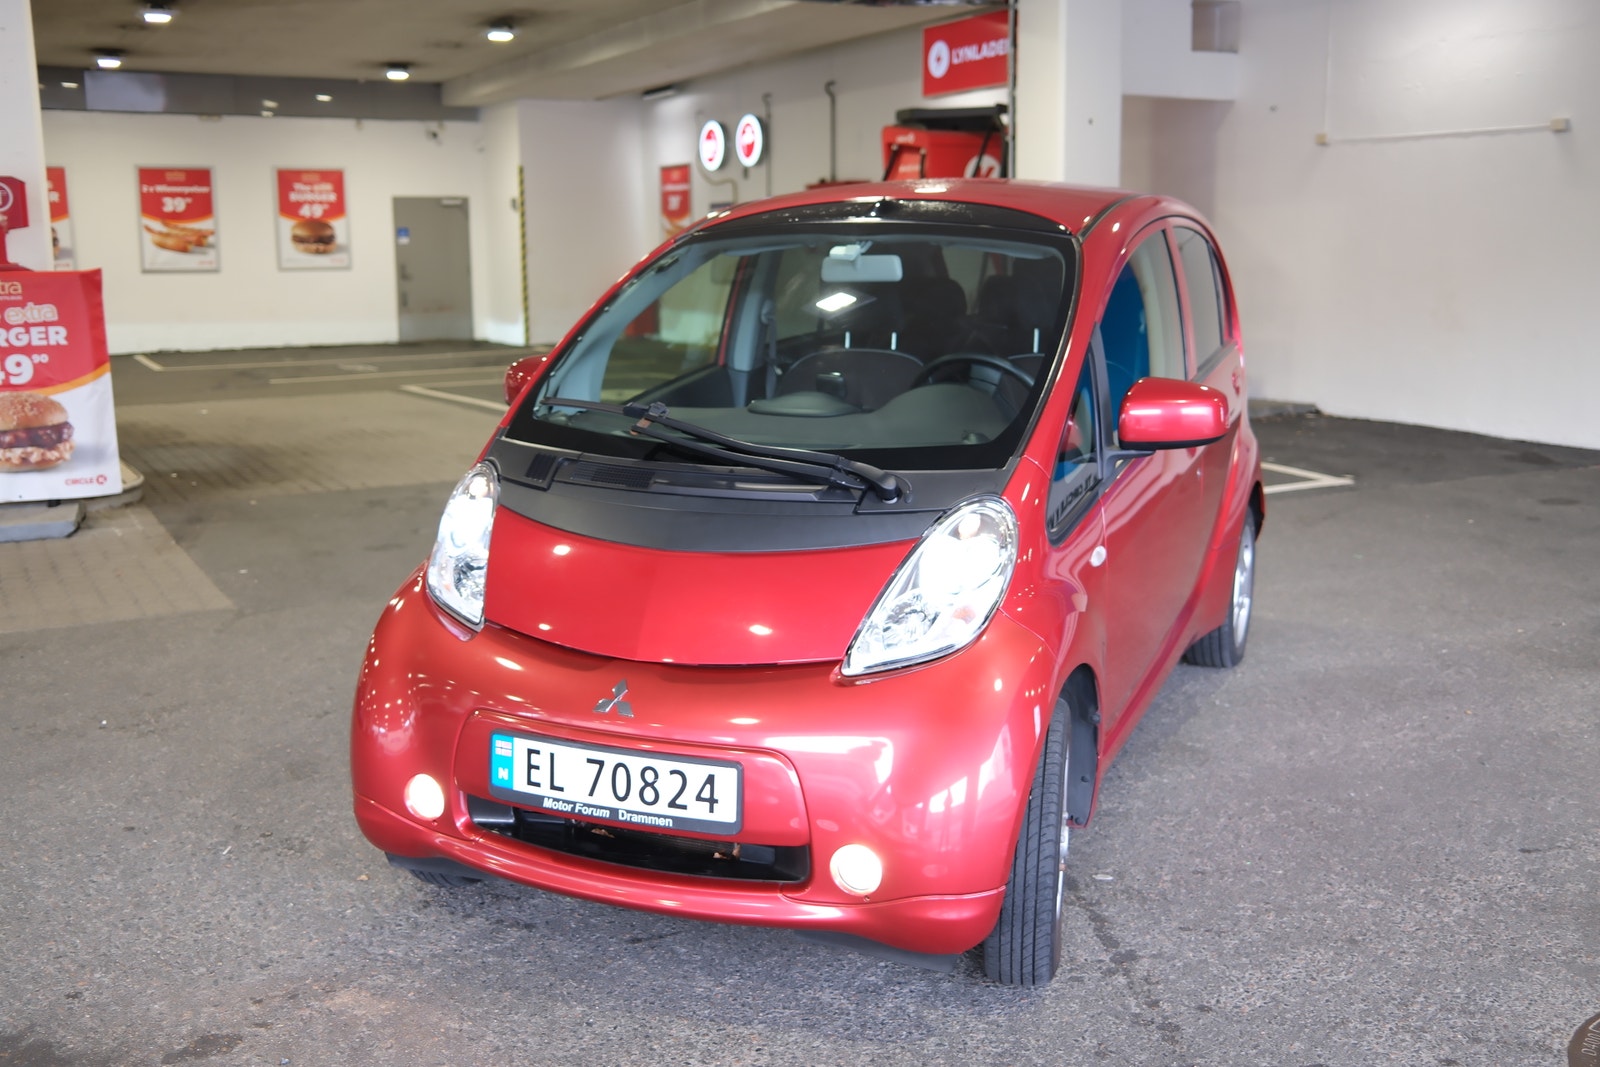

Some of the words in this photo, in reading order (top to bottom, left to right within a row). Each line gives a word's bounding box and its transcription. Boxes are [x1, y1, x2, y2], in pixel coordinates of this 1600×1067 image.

[4, 302, 58, 325] extra
[0, 354, 34, 385] 9
[526, 748, 565, 792] EL
[586, 757, 719, 814] 70824
[543, 797, 574, 812] Motor
[575, 802, 610, 818] Forum
[618, 809, 673, 827] Drammen
